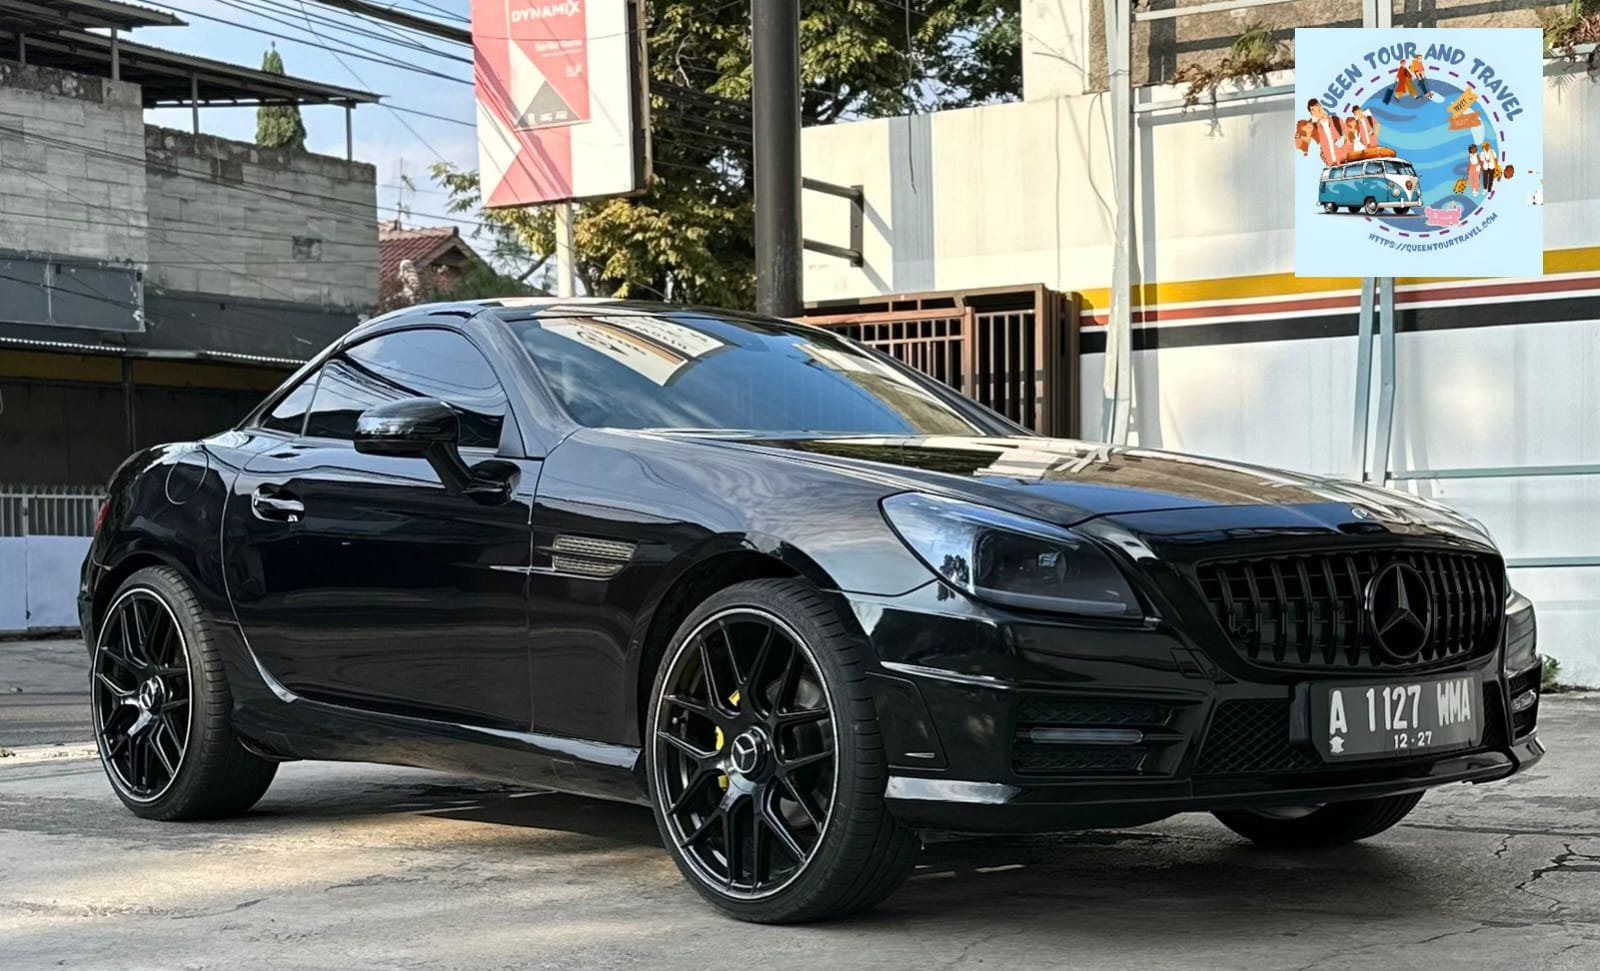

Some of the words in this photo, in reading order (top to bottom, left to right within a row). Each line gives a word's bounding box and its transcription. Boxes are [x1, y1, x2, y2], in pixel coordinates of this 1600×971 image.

[511, 0, 580, 23] DYNAMIX
[1329, 690, 1348, 735] A
[1366, 684, 1421, 732] 1127
[1436, 678, 1471, 727] WMA
